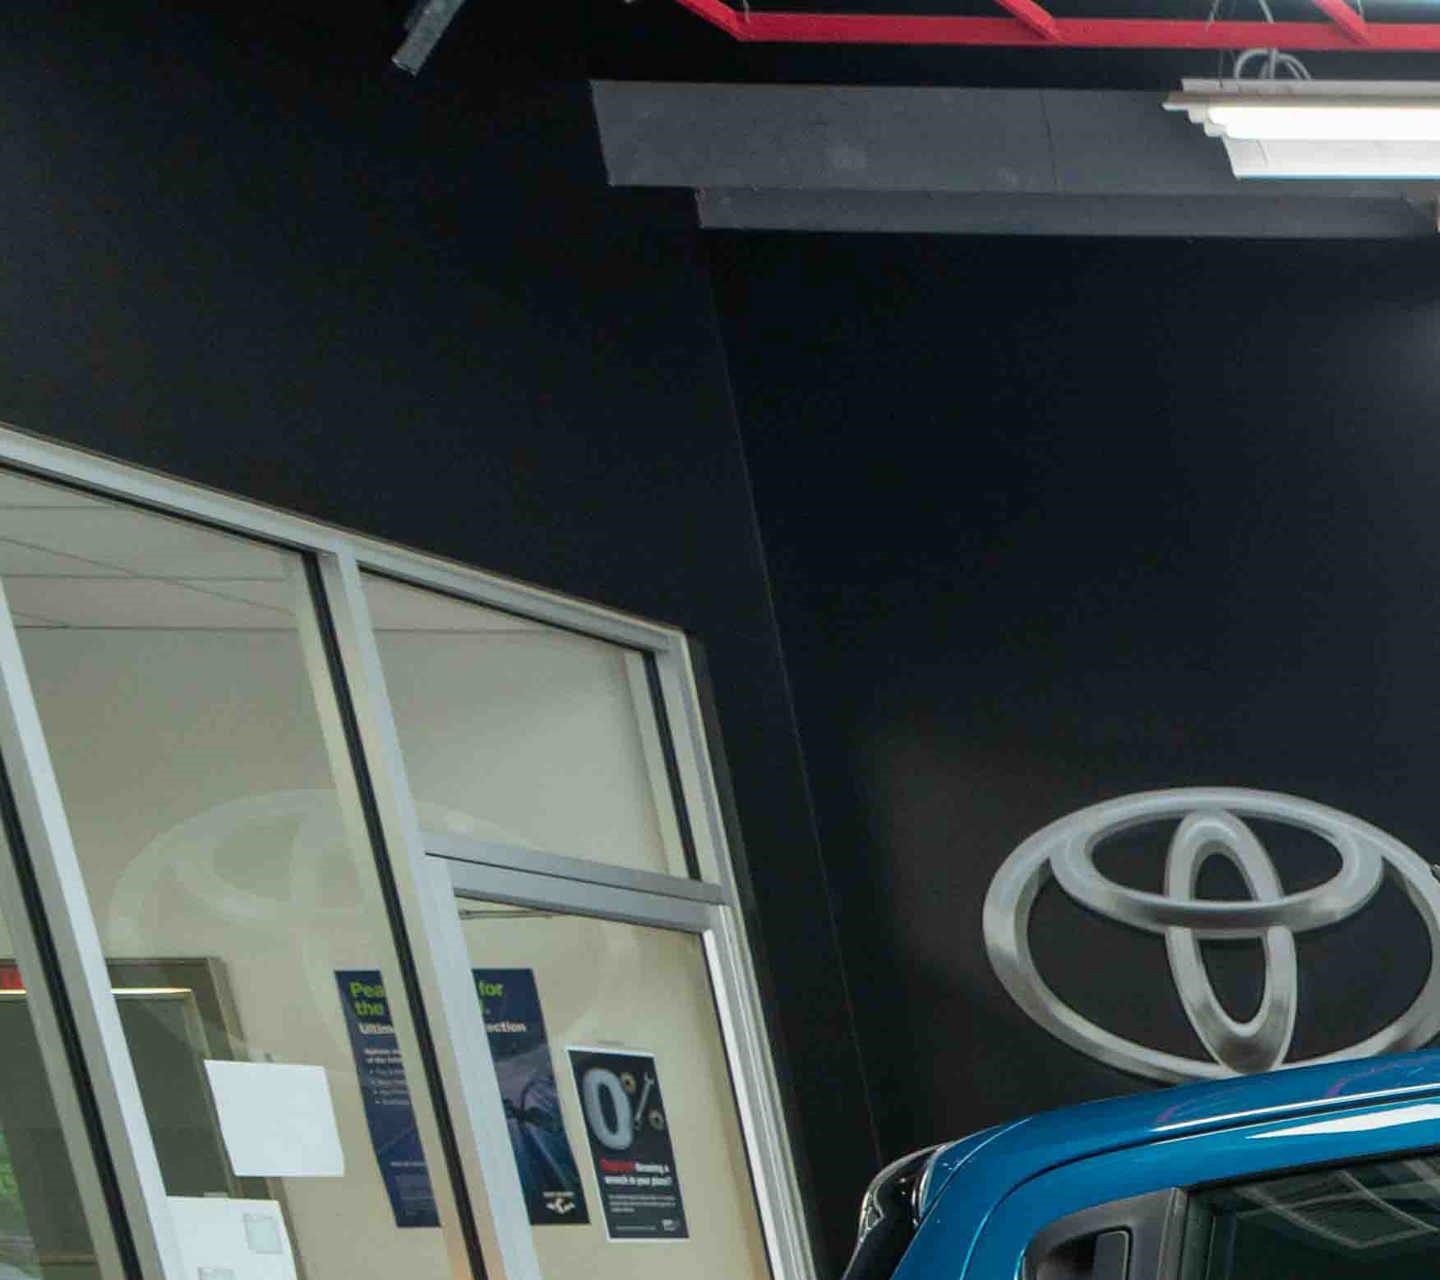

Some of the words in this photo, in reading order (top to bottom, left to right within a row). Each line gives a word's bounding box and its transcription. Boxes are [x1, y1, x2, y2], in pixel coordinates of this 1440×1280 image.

[350, 981, 385, 998] Pea
[355, 1001, 384, 1017] the
[485, 1021, 527, 1033] ection
